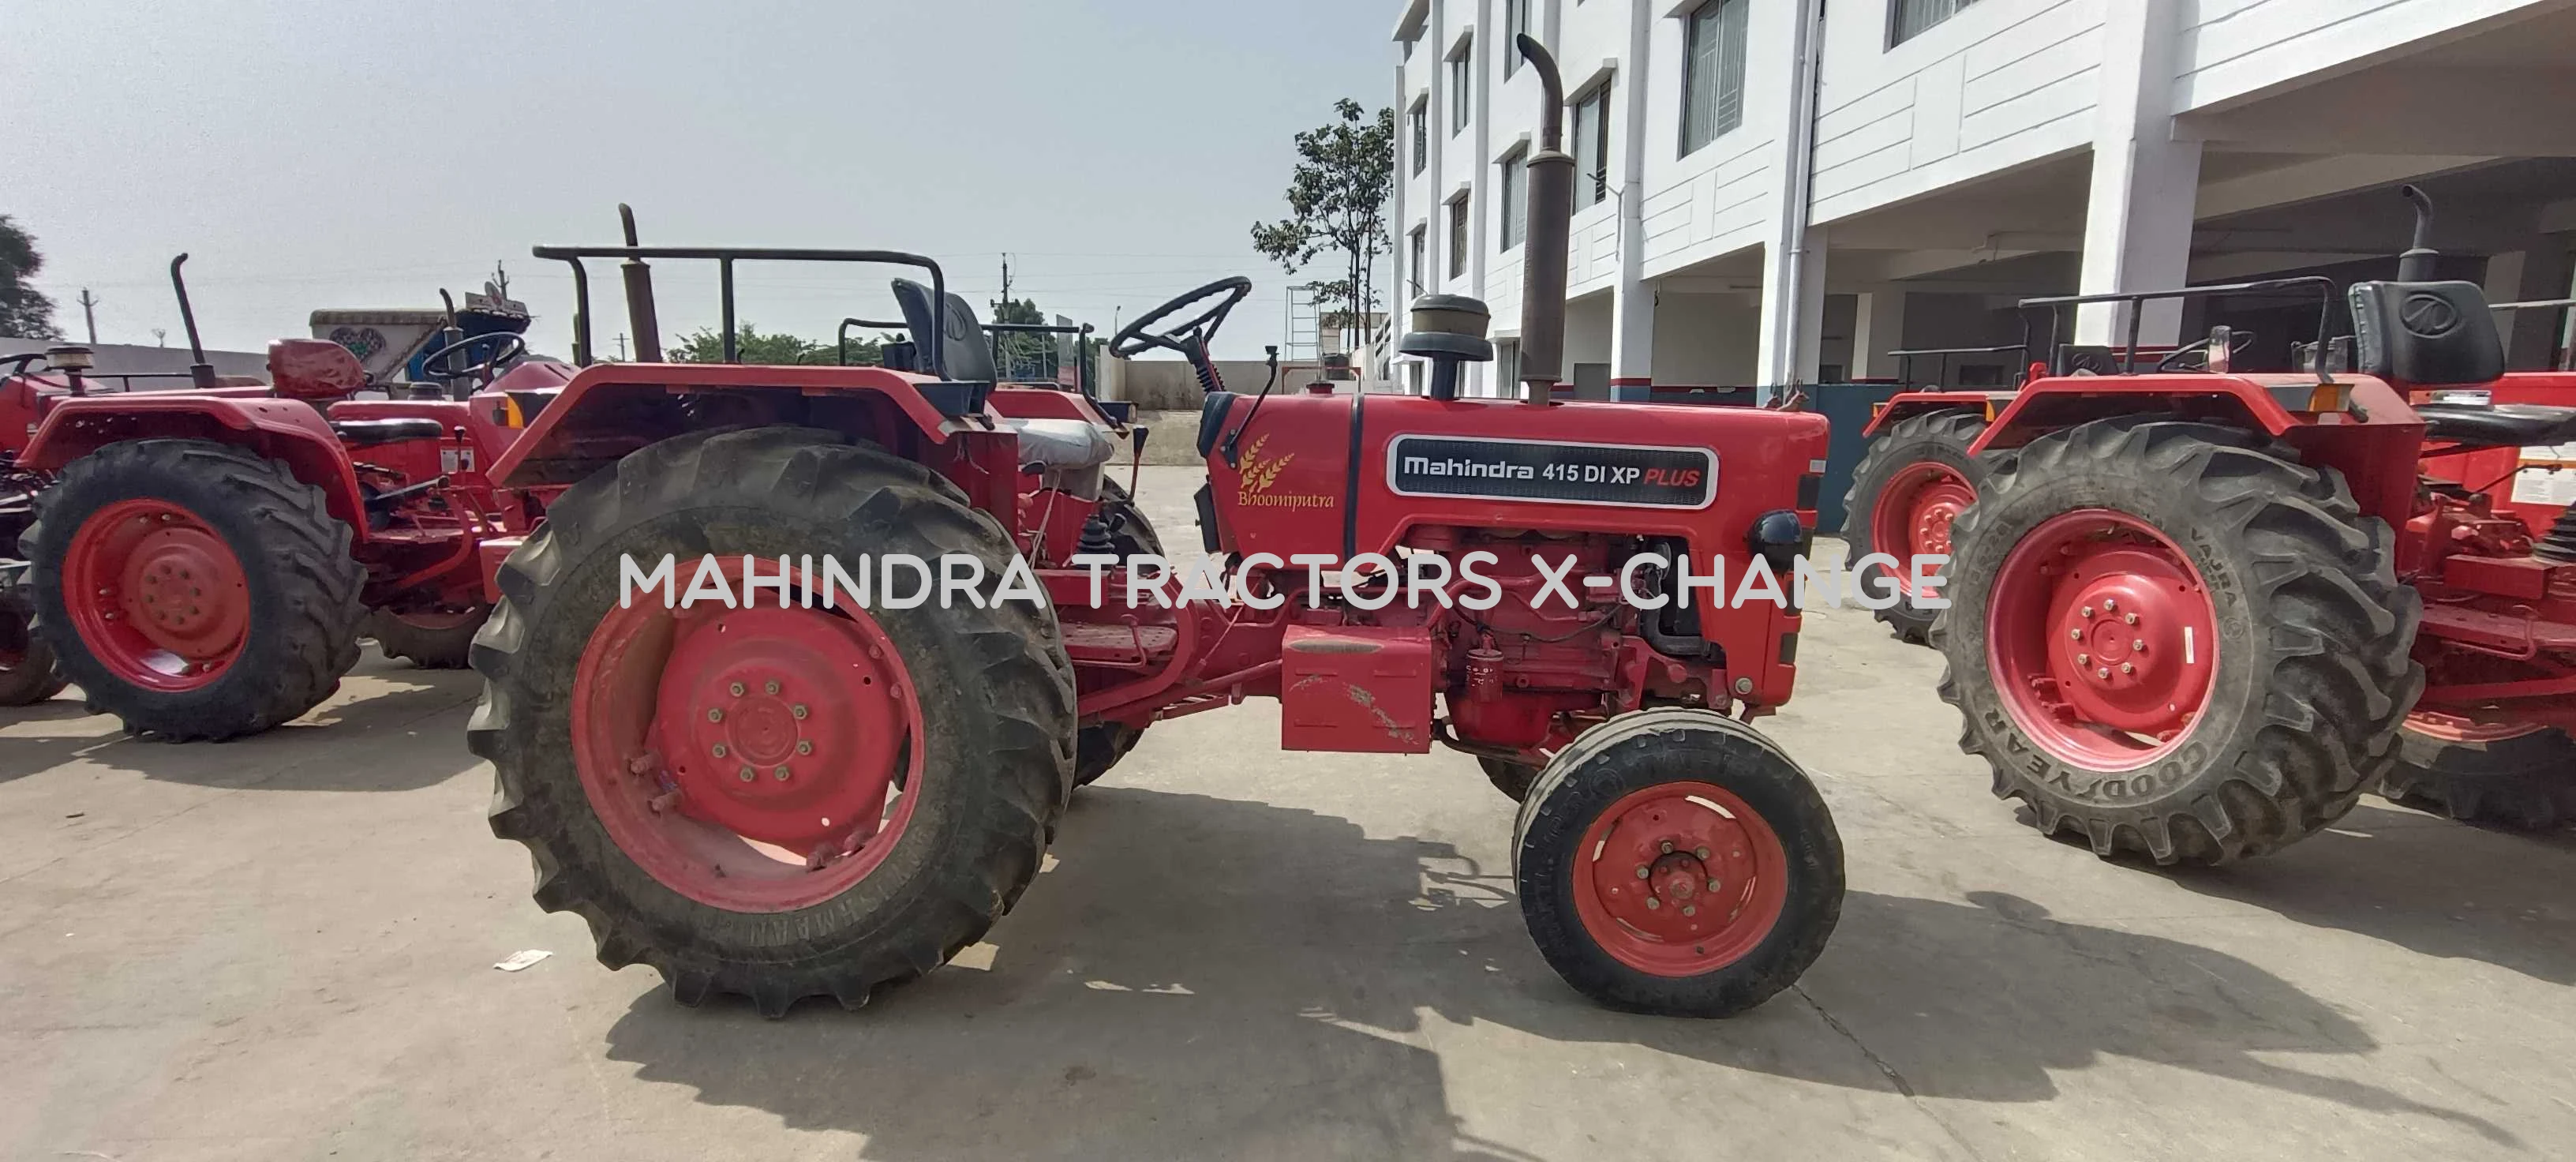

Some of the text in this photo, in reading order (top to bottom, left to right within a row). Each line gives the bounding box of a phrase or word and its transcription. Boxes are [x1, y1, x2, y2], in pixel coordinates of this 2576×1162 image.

[1405, 456, 1701, 487] Mahindra 415 DI XP PLUS
[1237, 490, 1335, 512] Bhoomiputra
[2191, 527, 2237, 608] VAJRA
[1983, 707, 2208, 798] GOODYEAR
